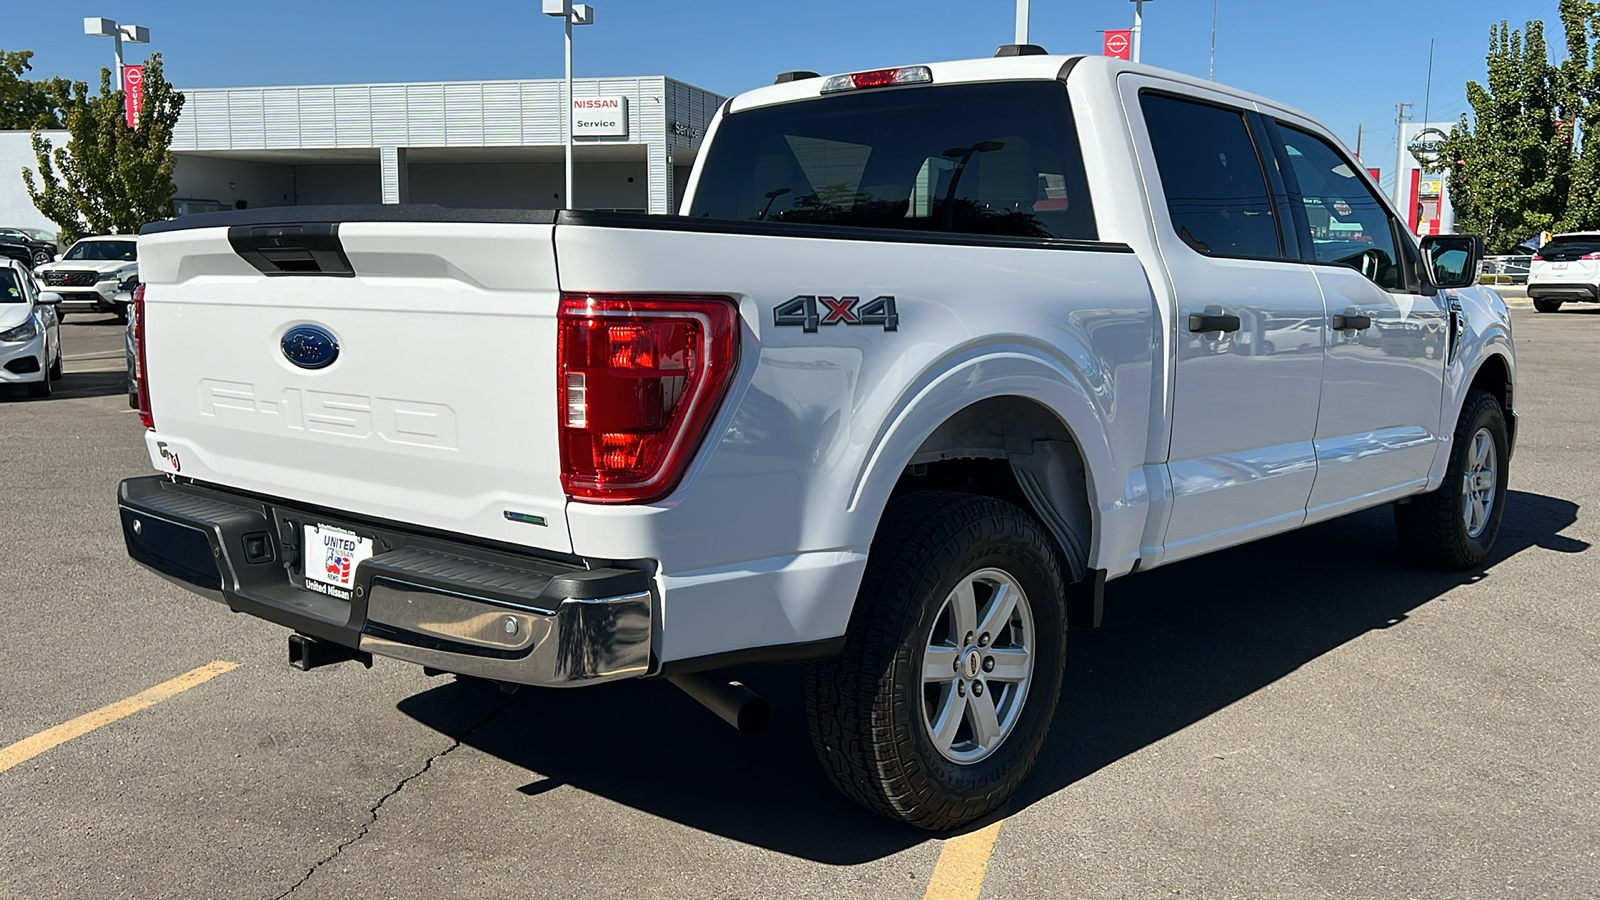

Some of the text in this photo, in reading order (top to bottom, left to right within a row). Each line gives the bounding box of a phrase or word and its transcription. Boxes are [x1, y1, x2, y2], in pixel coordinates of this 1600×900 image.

[574, 99, 618, 109] NISSAN
[577, 119, 616, 128] Service
[674, 121, 699, 138] Service
[290, 333, 322, 359] Ford
[199, 377, 457, 451] F-150
[323, 535, 356, 552] UNITED
[334, 549, 354, 558] NISSAN
[305, 578, 327, 594] United
[327, 585, 350, 601] Nissan
